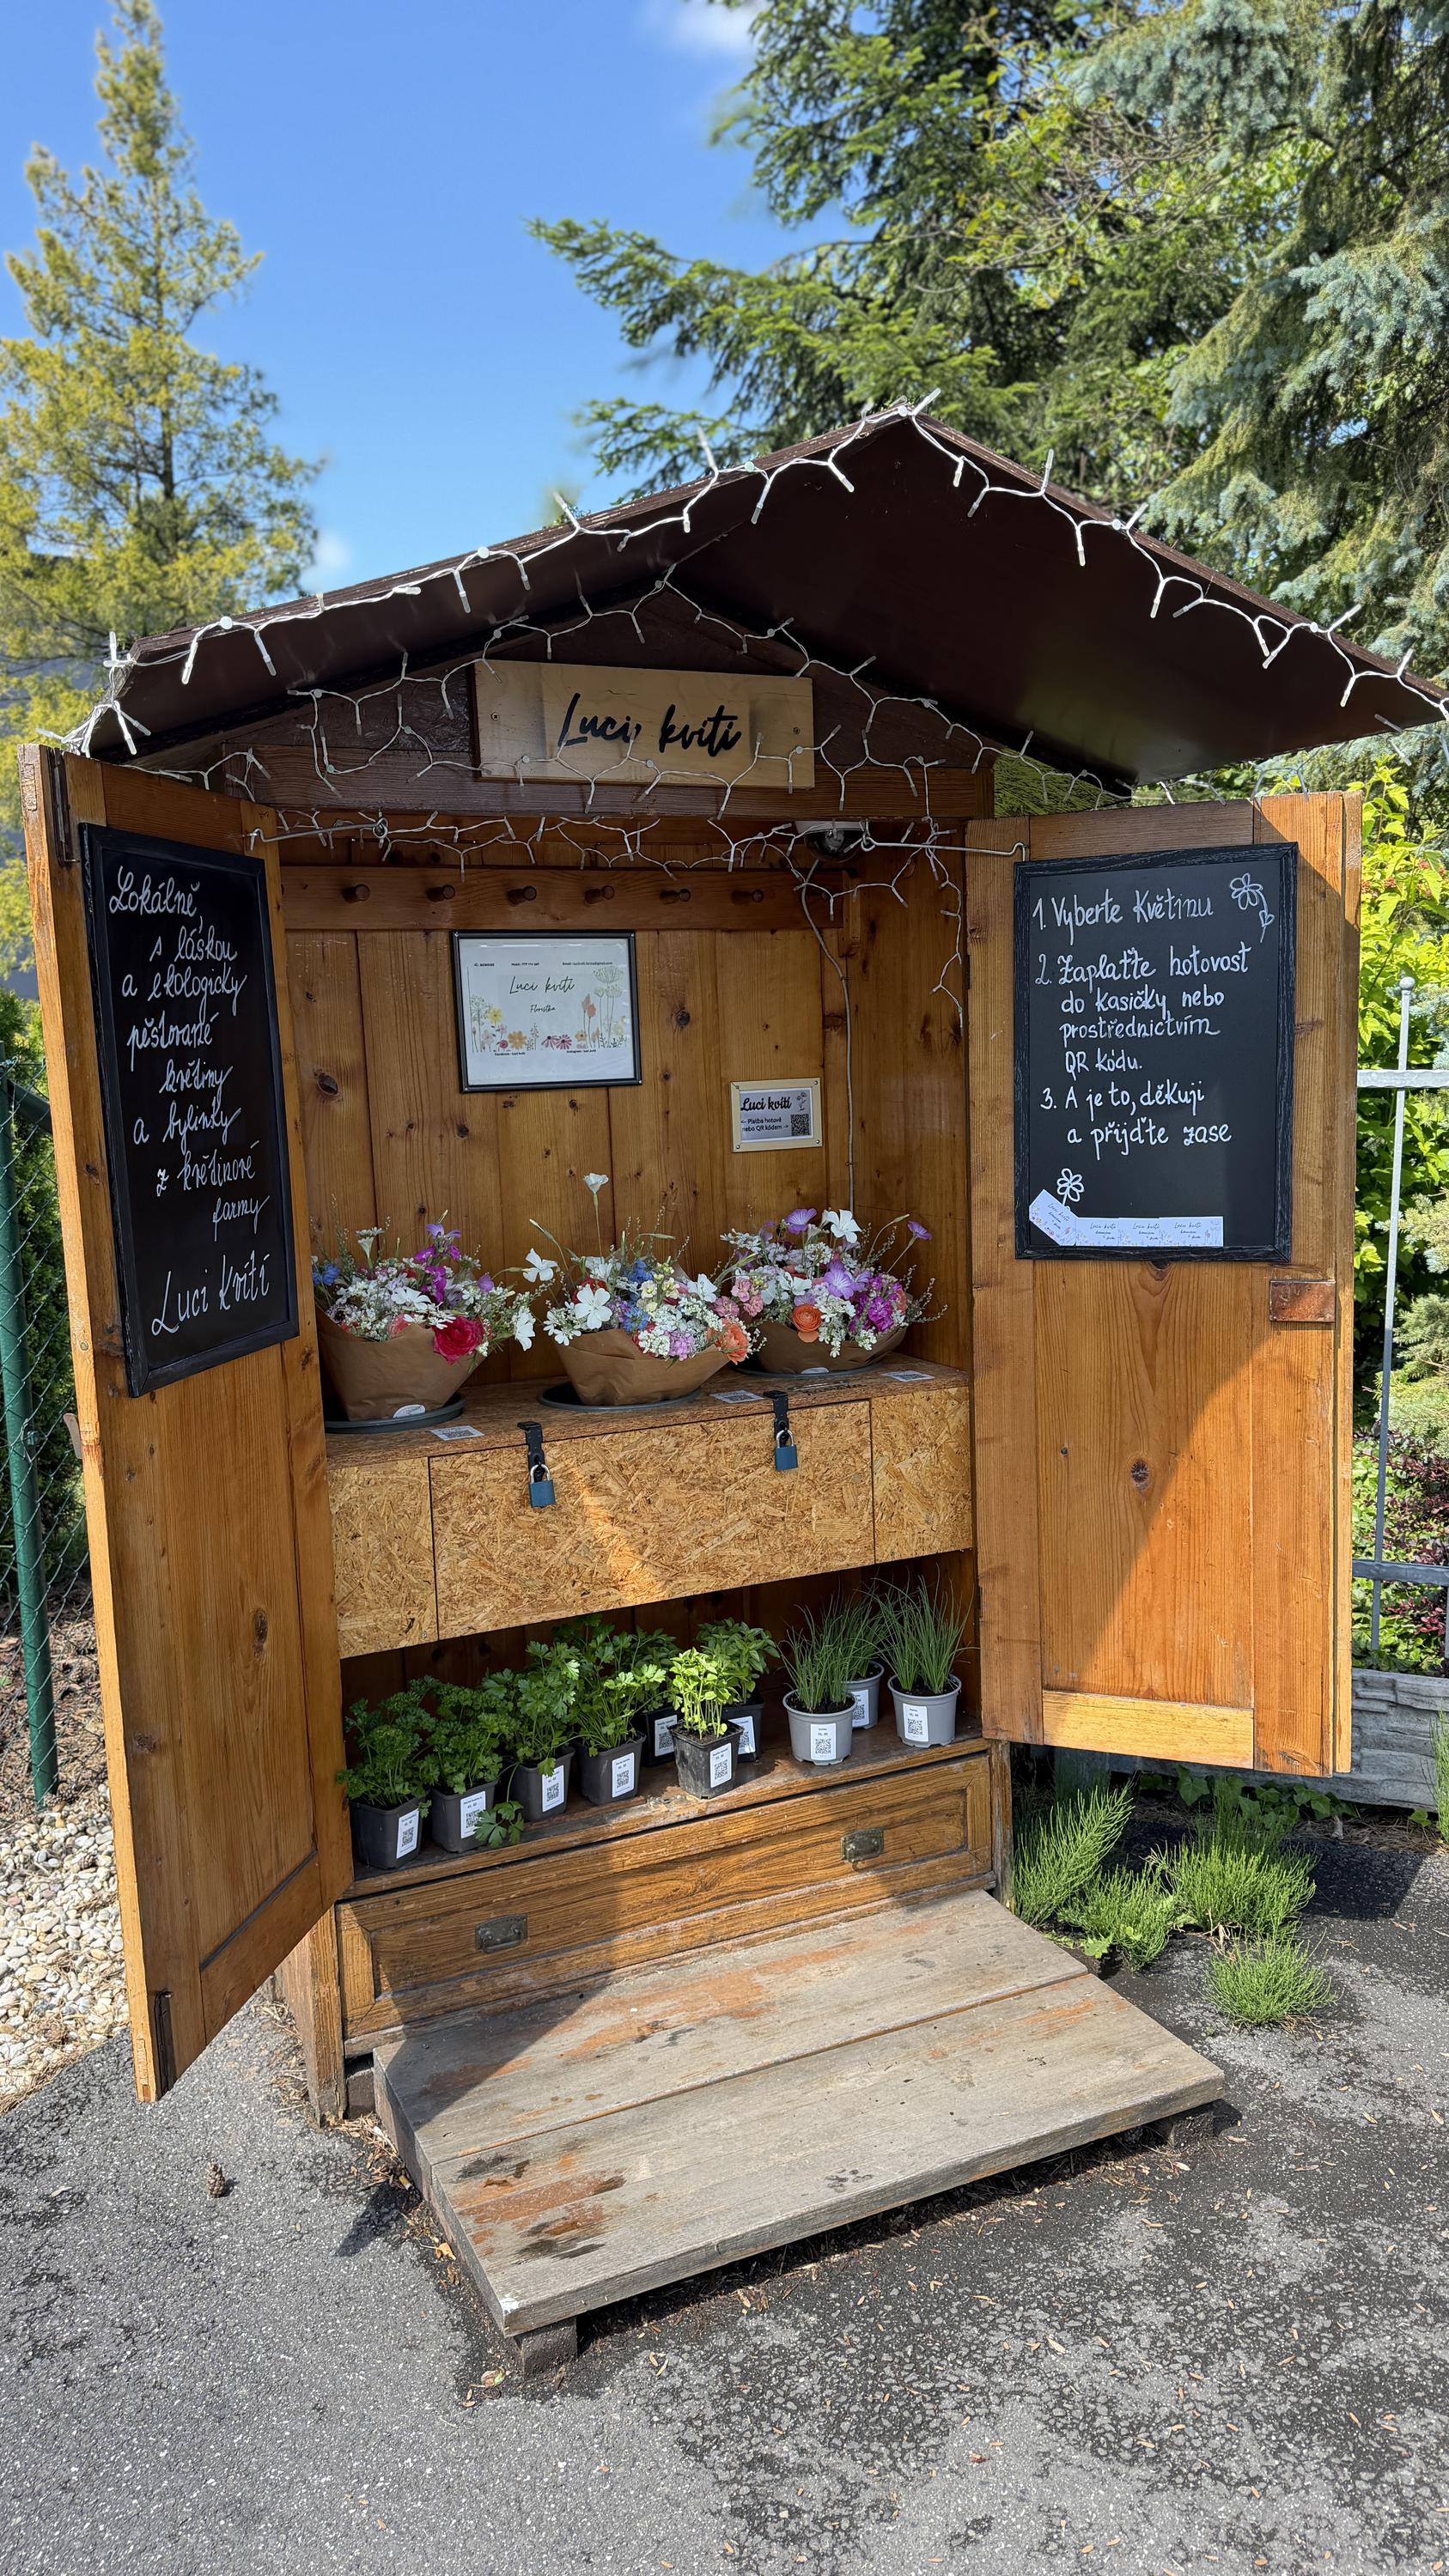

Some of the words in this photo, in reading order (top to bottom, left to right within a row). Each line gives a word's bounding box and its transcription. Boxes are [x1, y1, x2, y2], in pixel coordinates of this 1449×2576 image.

[558, 692, 642, 747] Luci
[1032, 897, 1046, 930] 1.
[1051, 889, 1123, 945] Vyberte
[1133, 888, 1214, 923] Květinu
[174, 925, 238, 963] láskou
[1035, 953, 1052, 985] 2.
[1057, 947, 1156, 993] Zaplaťte
[1169, 941, 1252, 976] hotovost
[122, 974, 138, 997] a
[148, 962, 247, 1026] ekologicky
[509, 975, 538, 993] Luci
[1061, 990, 1085, 1014] do
[1182, 984, 1224, 1007] nebo
[126, 1010, 219, 1072] pěstované
[1059, 1011, 1221, 1048] prostřednictvím
[159, 1058, 234, 1103] květiny
[1065, 1051, 1089, 1081] QR
[740, 1097, 765, 1111] Luci
[768, 1096, 792, 1110] kvítí
[1040, 1088, 1057, 1109] 3.
[1065, 1086, 1078, 1109] A
[1086, 1089, 1103, 1121] je
[1140, 1078, 1204, 1115] děkuji
[133, 1117, 149, 1145] a
[162, 1098, 241, 1155] bylinky
[1067, 1128, 1082, 1144] a
[1090, 1117, 1168, 1160] přijďte
[1183, 1124, 1232, 1146] zase
[177, 1140, 259, 1190] květinové
[212, 1195, 270, 1242] farmy
[151, 1268, 208, 1336] Luci
